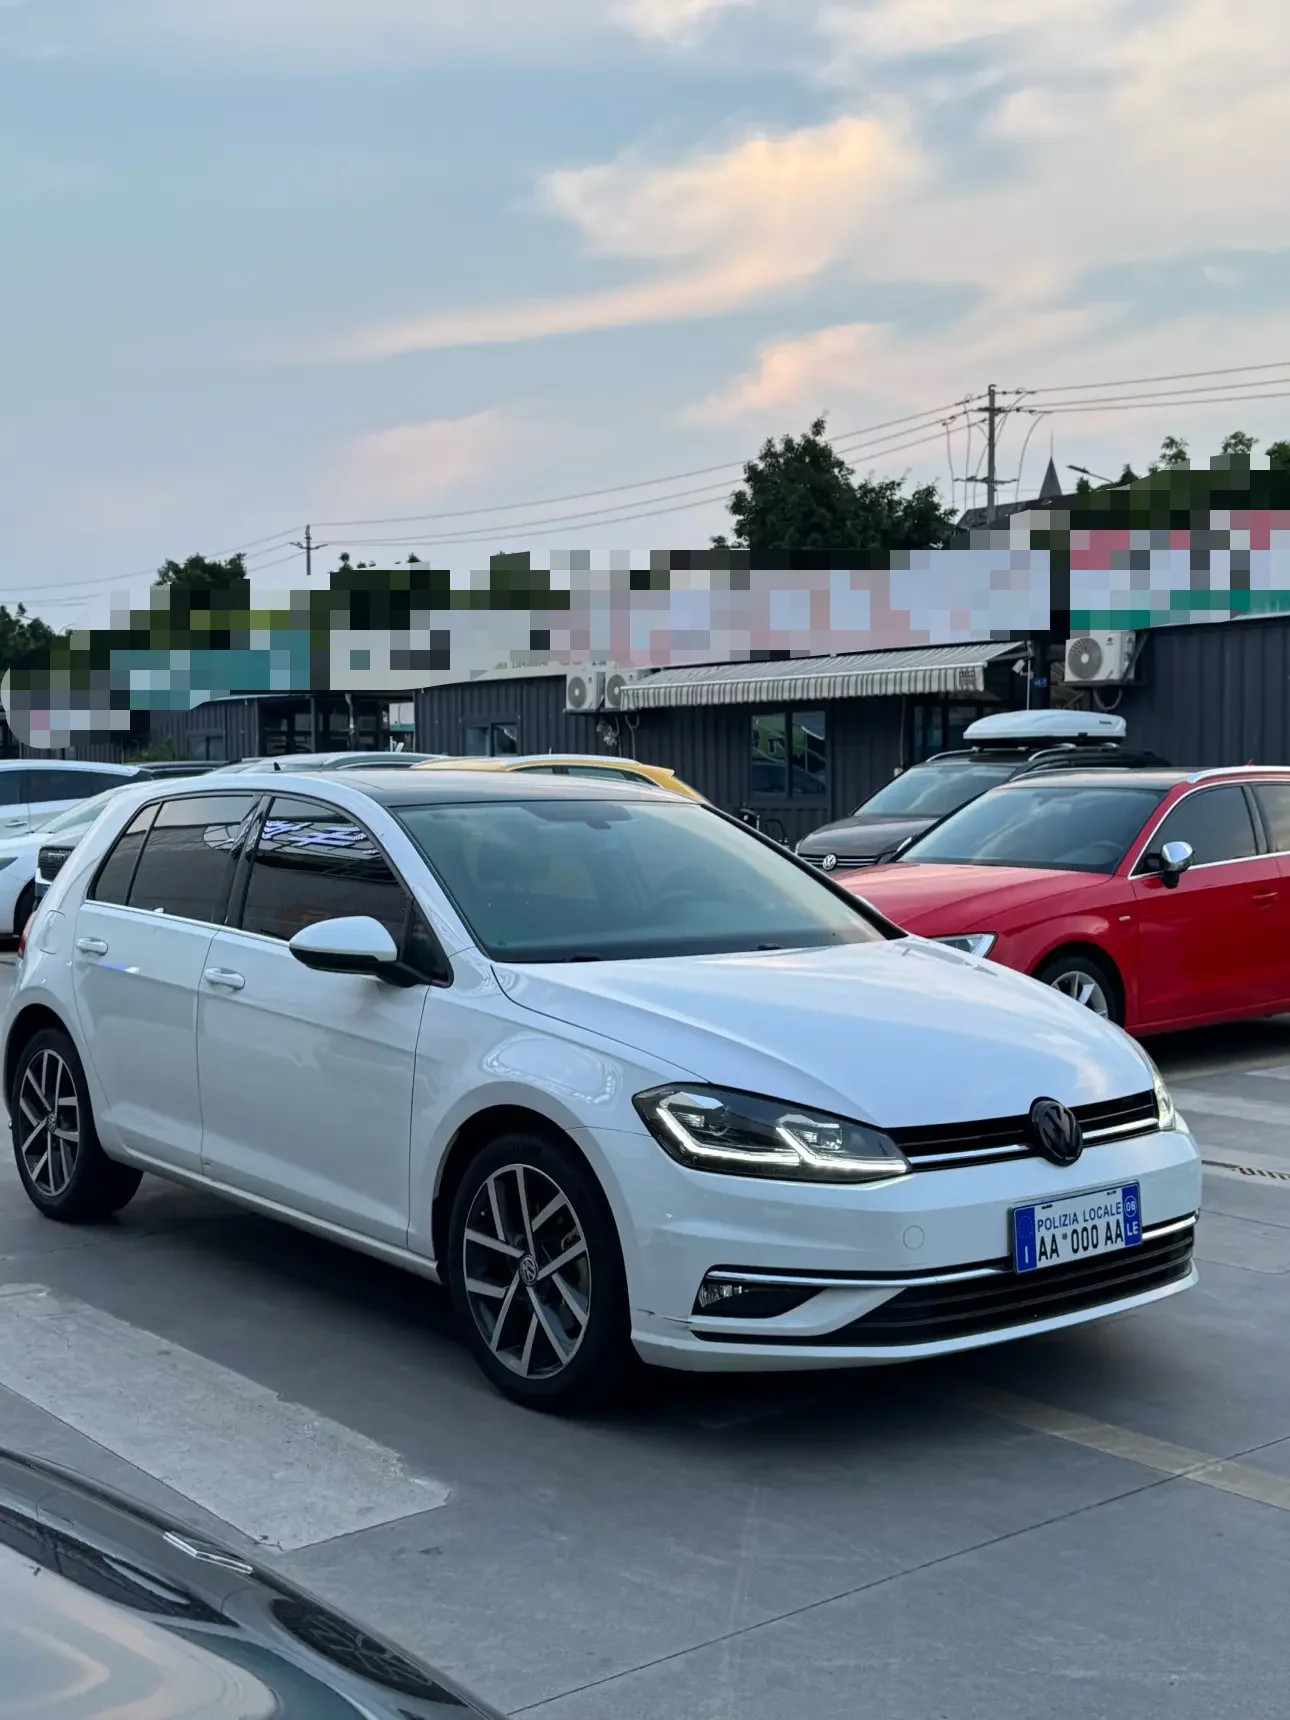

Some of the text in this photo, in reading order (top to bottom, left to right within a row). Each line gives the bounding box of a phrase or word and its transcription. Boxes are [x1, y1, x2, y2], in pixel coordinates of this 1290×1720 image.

[1037, 1201, 1122, 1233] POLIZIA LOCALE
[1126, 1221, 1139, 1236] LE
[1038, 1218, 1124, 1262] AA 000 AA
